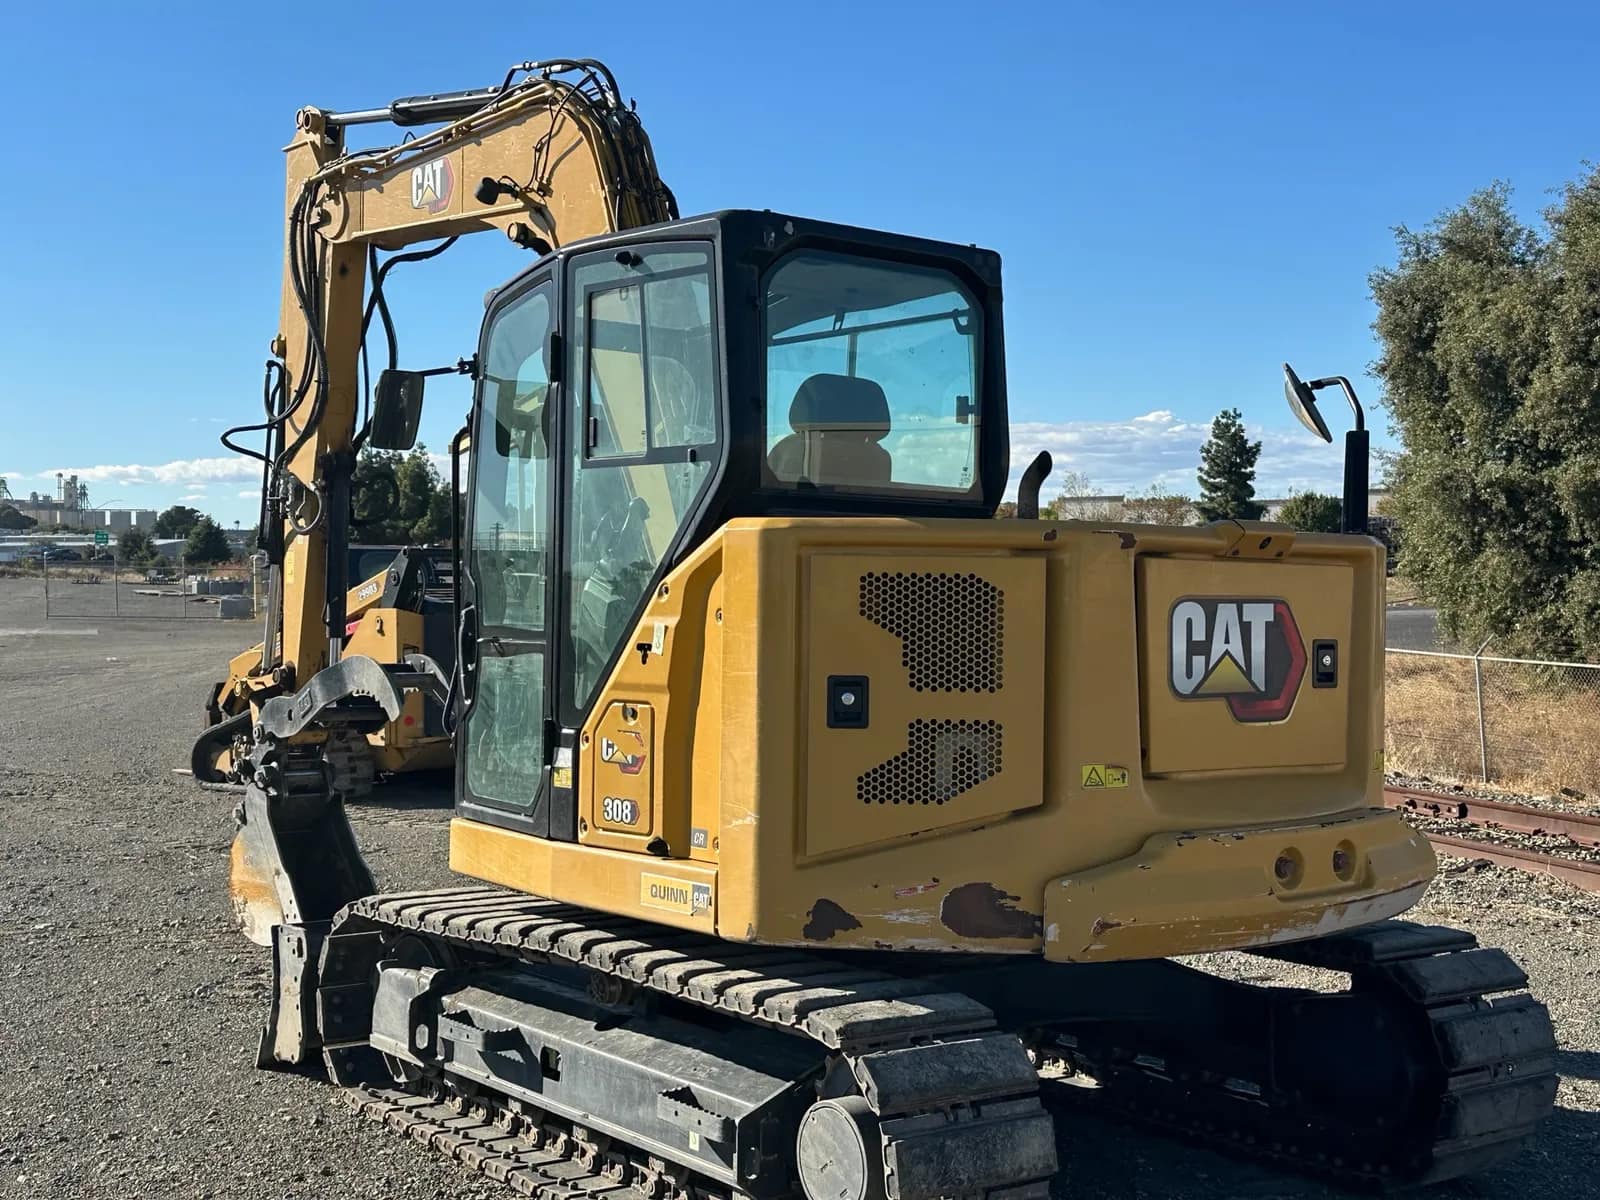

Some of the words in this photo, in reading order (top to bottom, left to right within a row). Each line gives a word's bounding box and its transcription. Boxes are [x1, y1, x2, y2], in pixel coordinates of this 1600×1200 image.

[412, 159, 444, 208] CAT
[1172, 601, 1275, 695] CAT
[603, 797, 631, 824] 308
[694, 832, 705, 846] CR
[650, 883, 688, 904] QUINN
